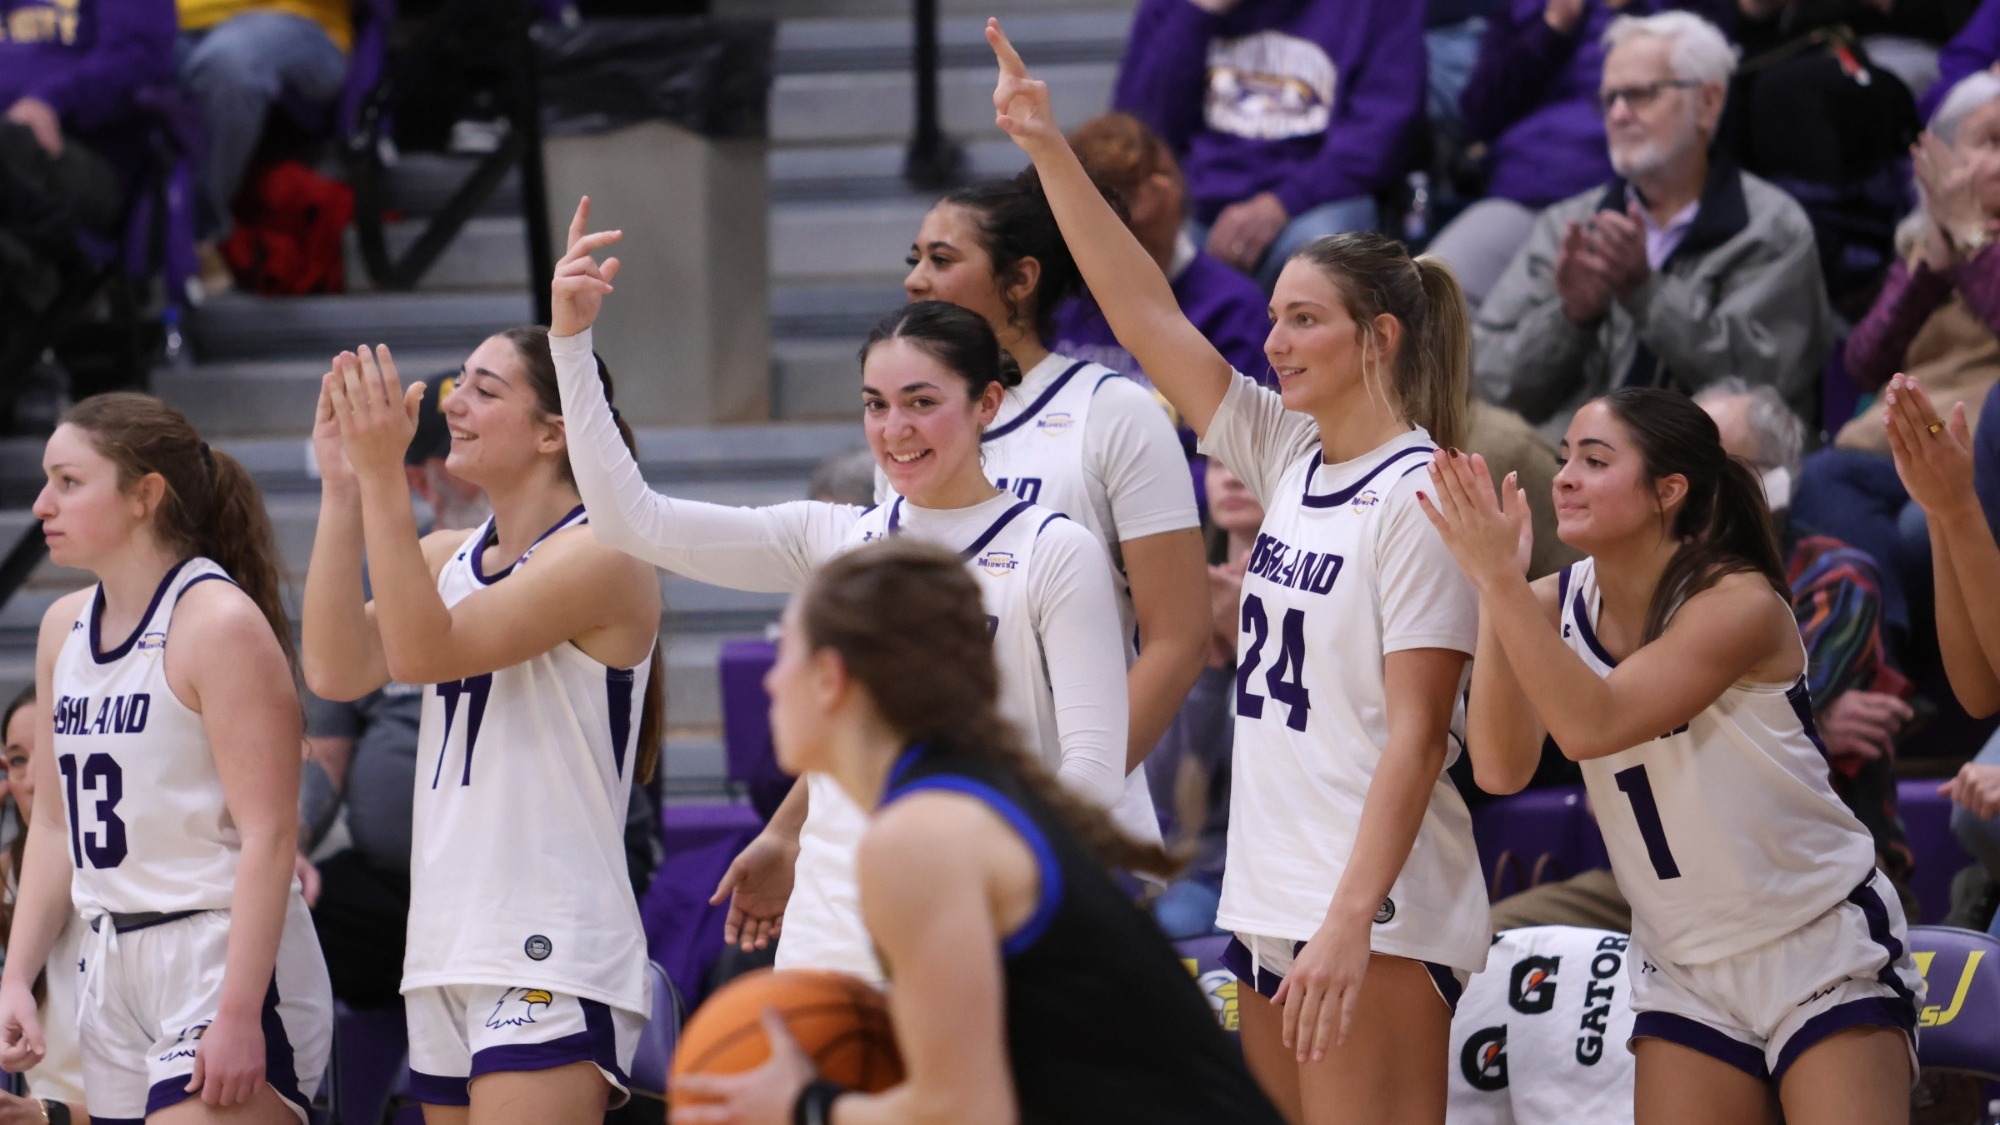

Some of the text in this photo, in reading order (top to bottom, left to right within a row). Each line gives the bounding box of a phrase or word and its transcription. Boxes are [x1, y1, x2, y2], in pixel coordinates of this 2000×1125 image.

[1236, 593, 1311, 732] 24
[58, 752, 128, 870] 13
[1614, 763, 1681, 880] 1
